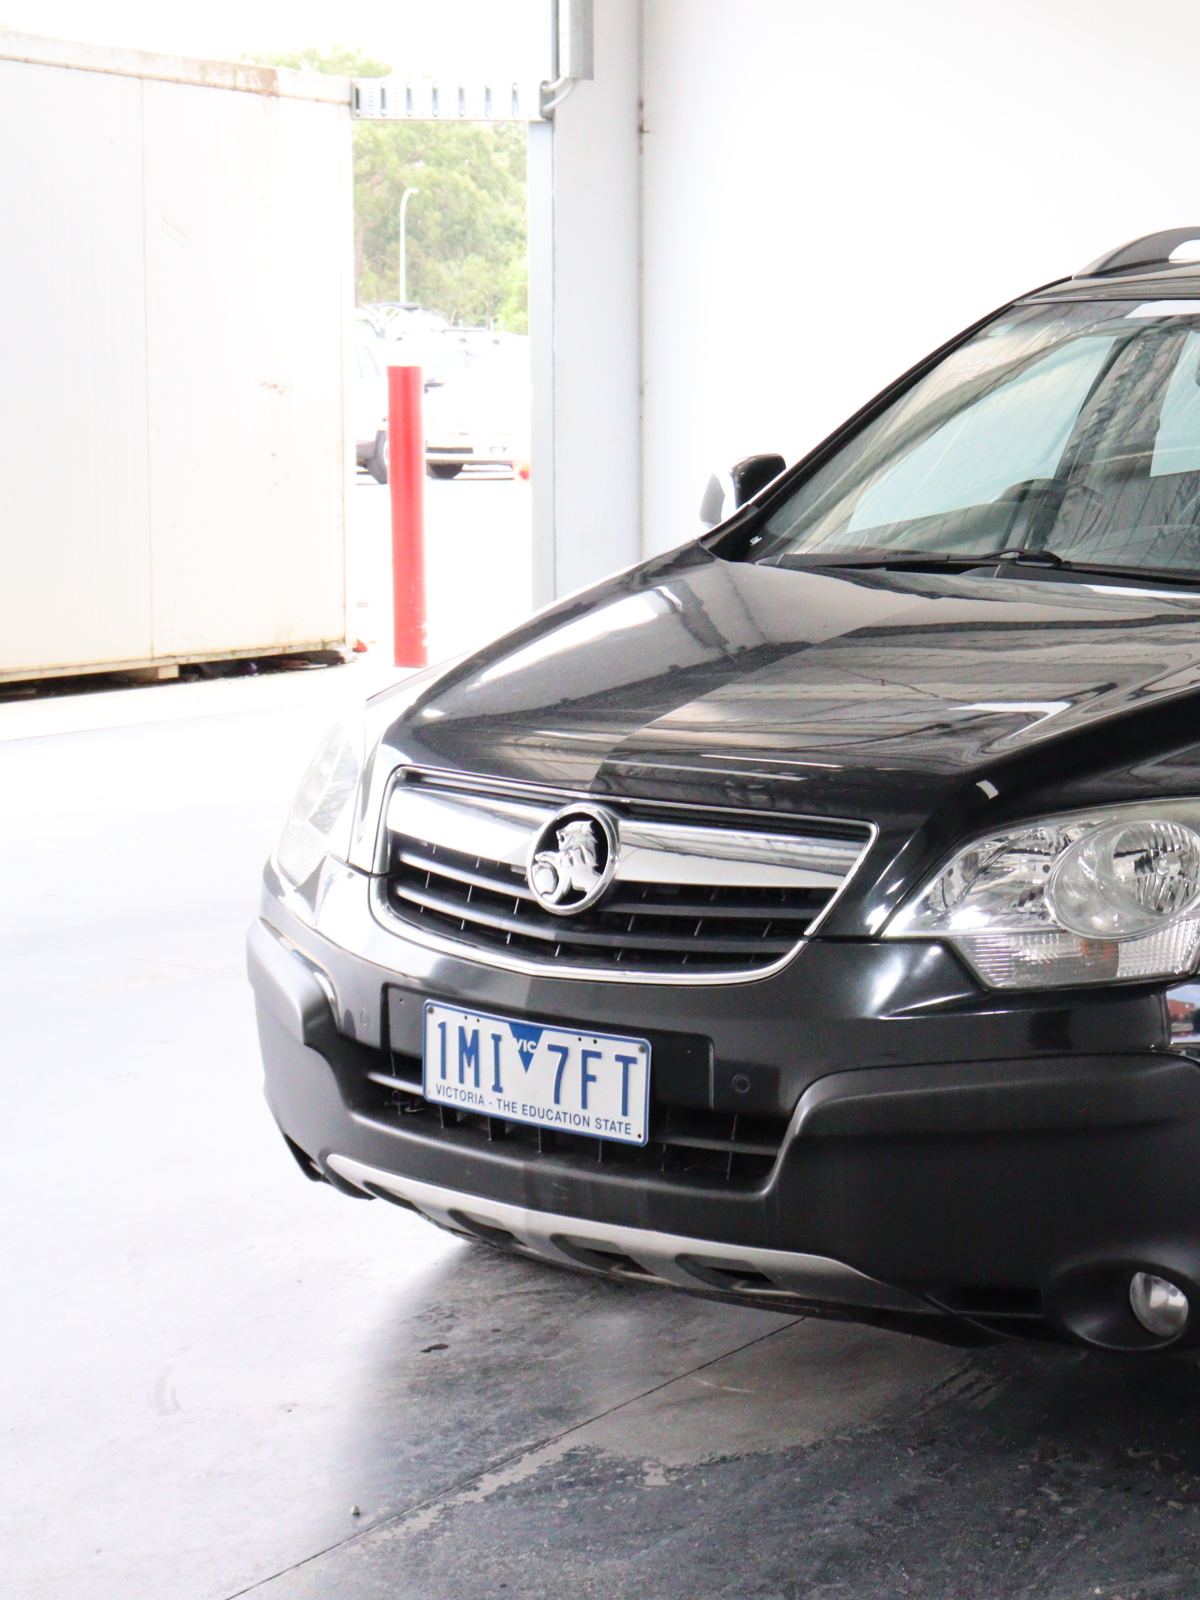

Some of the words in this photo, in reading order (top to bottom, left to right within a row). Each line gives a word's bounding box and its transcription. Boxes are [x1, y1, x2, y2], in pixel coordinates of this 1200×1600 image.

[515, 1037, 537, 1053] VIC
[547, 1043, 638, 1117] 7FT
[435, 1083, 485, 1107] VICTORIA
[496, 1098, 518, 1114] THE
[521, 1104, 590, 1128] EDUCATION
[594, 1117, 632, 1136] STATE
